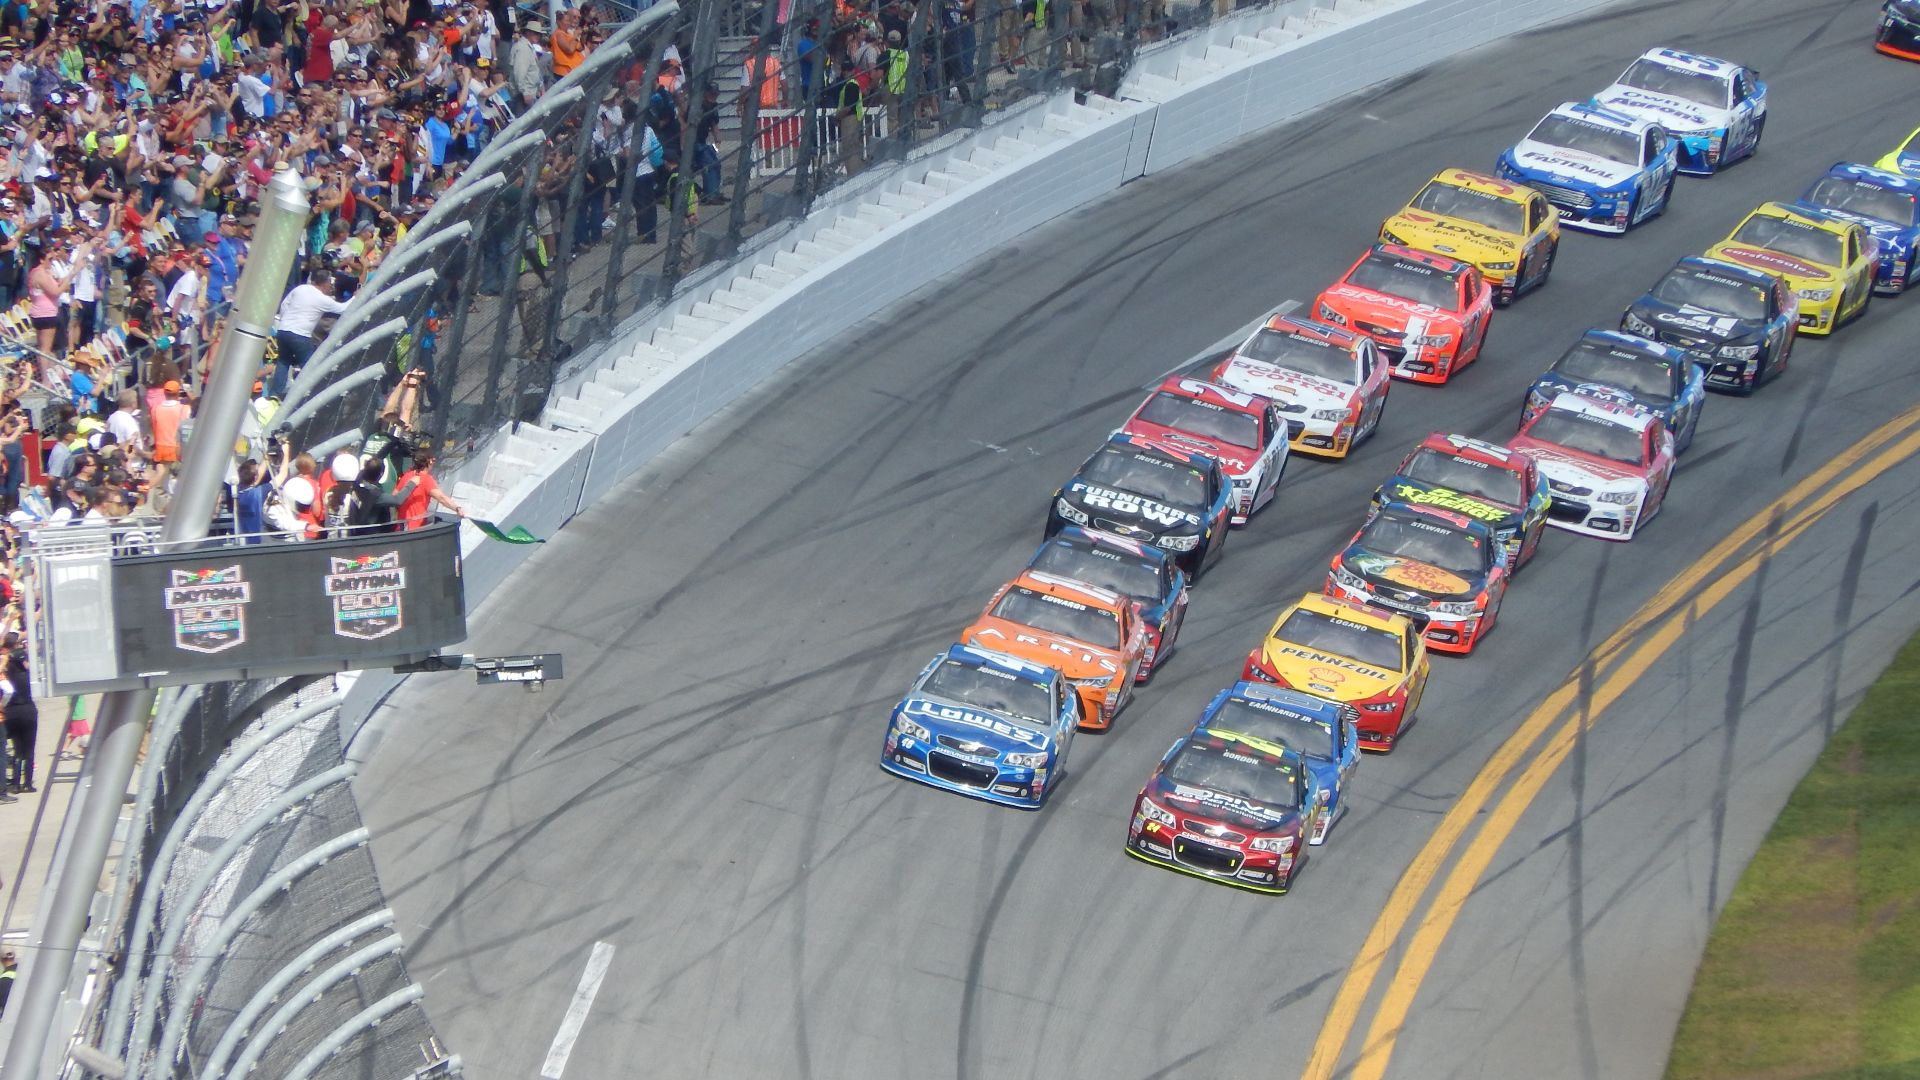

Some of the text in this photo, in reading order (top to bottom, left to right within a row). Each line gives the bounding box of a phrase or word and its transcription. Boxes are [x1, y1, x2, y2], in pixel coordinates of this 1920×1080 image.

[1522, 152, 1614, 178] FASTENAL
[1393, 262, 1432, 276] ALLGAIER
[1657, 313, 1729, 337] Cessna
[1071, 483, 1201, 526] FURNITURE
[1084, 494, 1181, 527] ROW
[1410, 521, 1452, 536] STEWART
[331, 573, 400, 592] DAYTONA
[172, 587, 243, 605] DAYTONA
[1041, 595, 1087, 611] EDWARDS
[1330, 617, 1368, 632] LOGANO
[976, 628, 1117, 673] ARRIS
[977, 666, 1017, 681] JOHNSON
[1280, 647, 1388, 681] PENNZOIL
[921, 702, 1035, 741] LOWE'S
[1176, 784, 1284, 819] DRIVE
